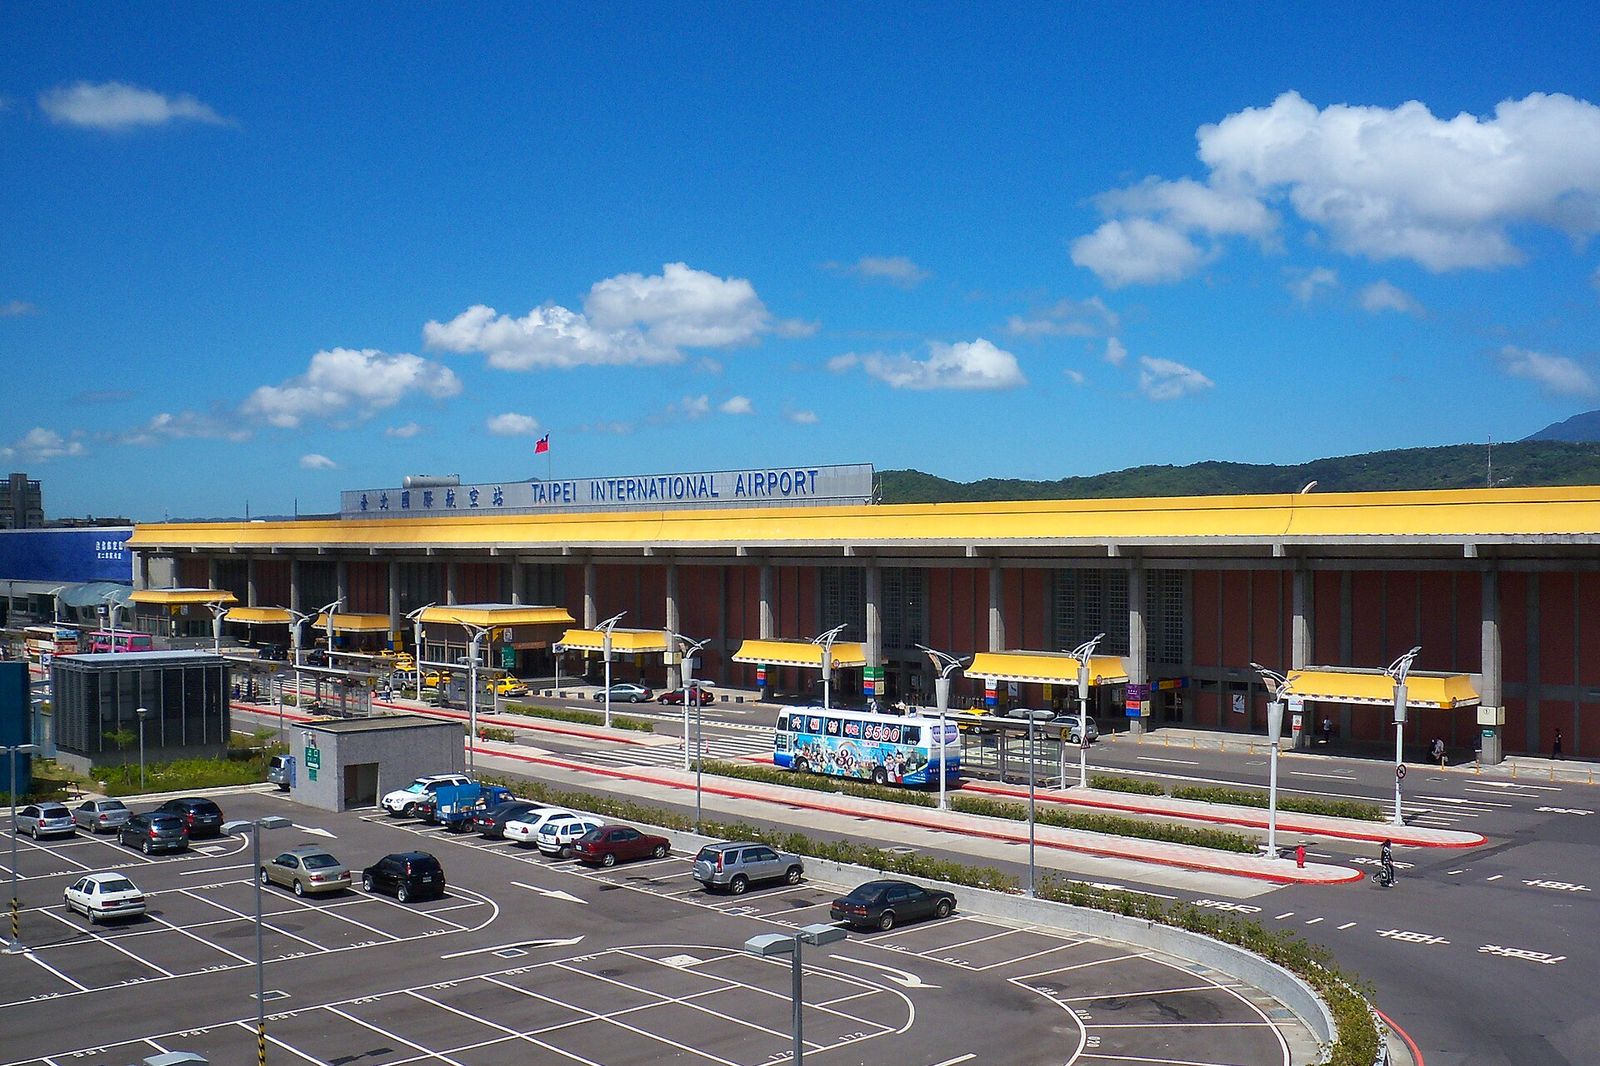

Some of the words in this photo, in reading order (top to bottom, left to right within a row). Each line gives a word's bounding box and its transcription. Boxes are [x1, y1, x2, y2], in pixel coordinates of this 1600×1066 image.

[531, 481, 577, 504] TAIPEI
[590, 475, 719, 502] INTERNATIONAL
[735, 470, 818, 497] AIRPORT
[1376, 929, 1450, 944] 車
[1478, 944, 1567, 964] 道
[838, 1032, 867, 1041] 172
